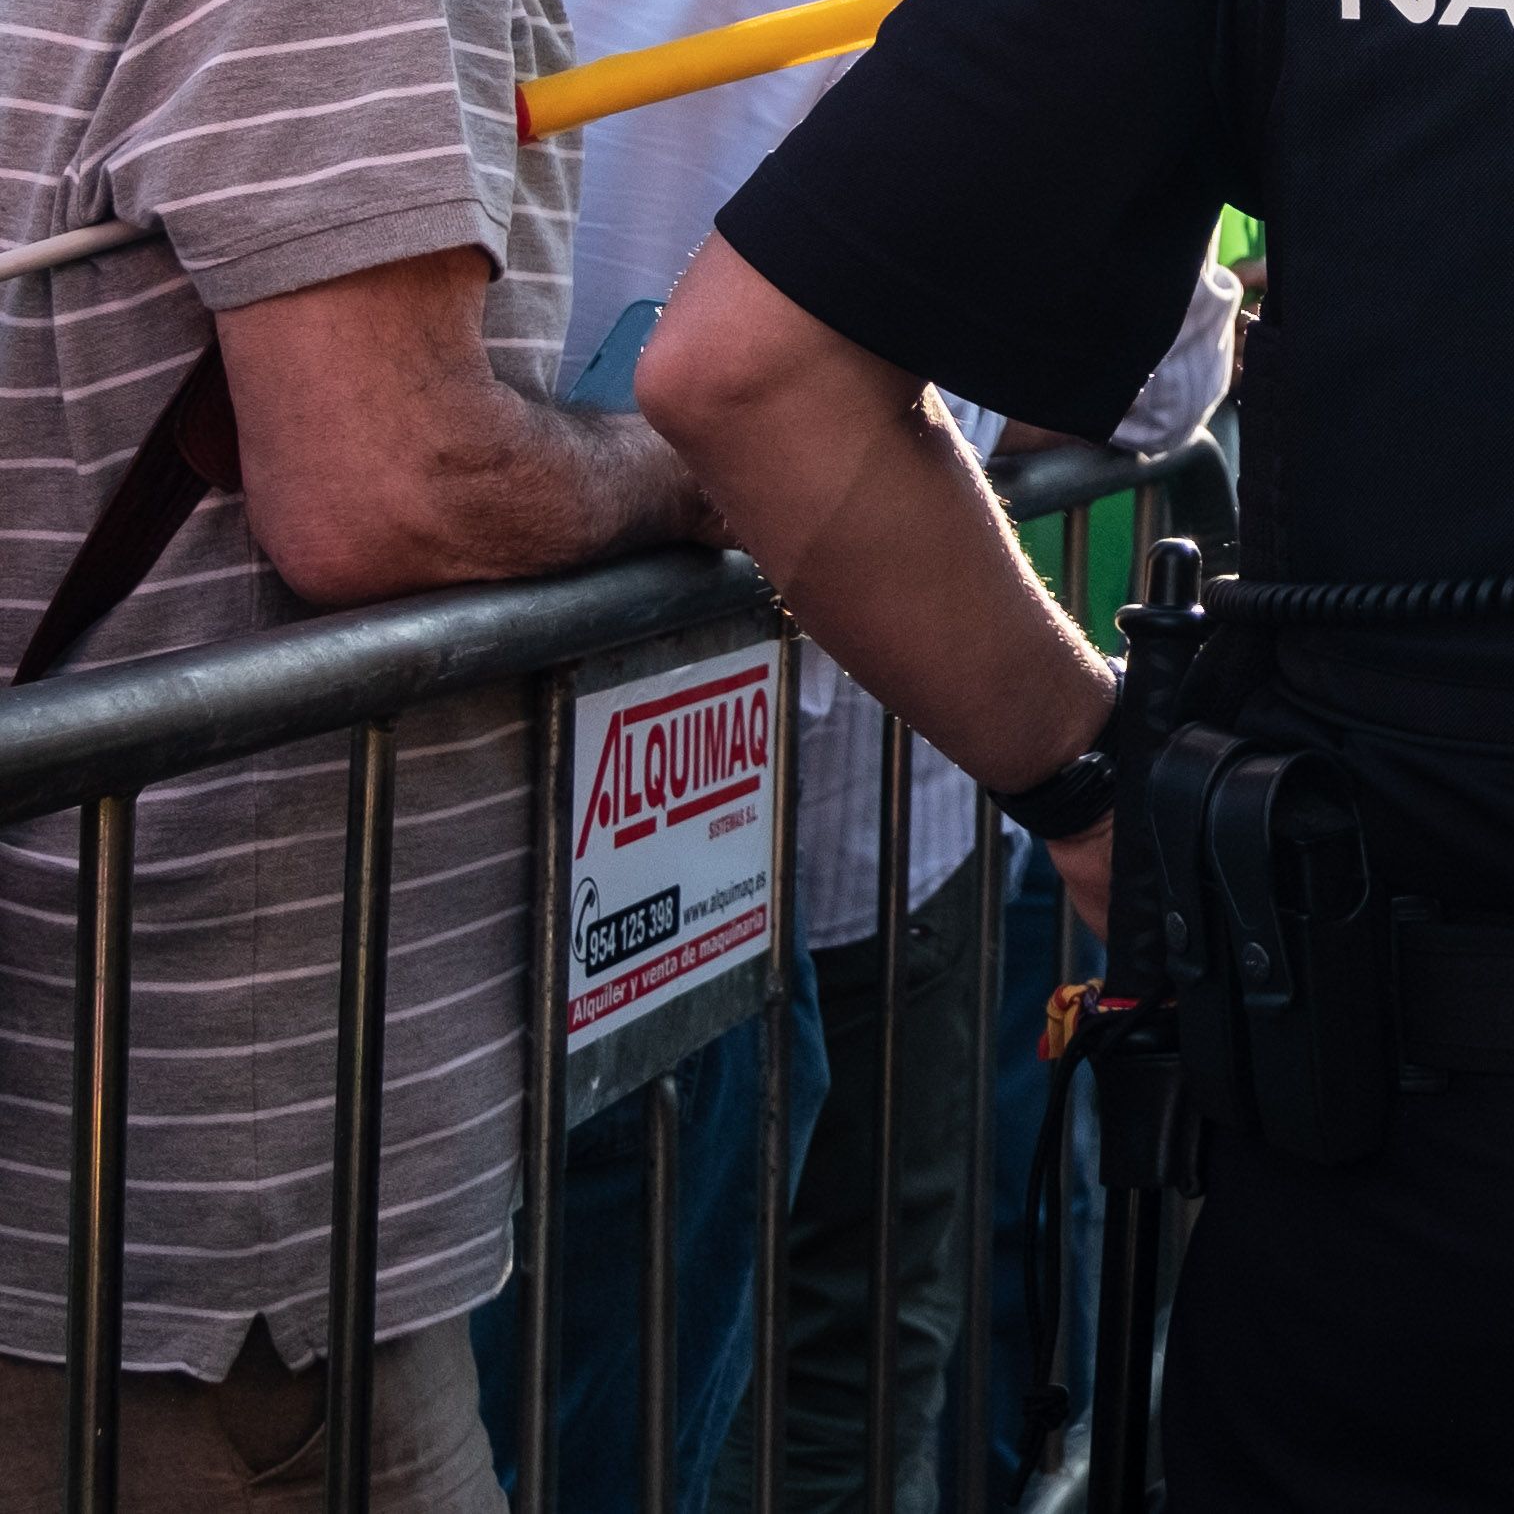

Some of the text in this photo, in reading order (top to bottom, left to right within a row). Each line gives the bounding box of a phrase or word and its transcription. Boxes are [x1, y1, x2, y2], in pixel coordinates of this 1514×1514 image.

[576, 686, 768, 861] ALQUIMAQ
[589, 894, 675, 967] 954 125 398
[683, 870, 767, 926] www.alquimaq.es
[572, 908, 765, 1027] Alquiler y venta de maquinaria
